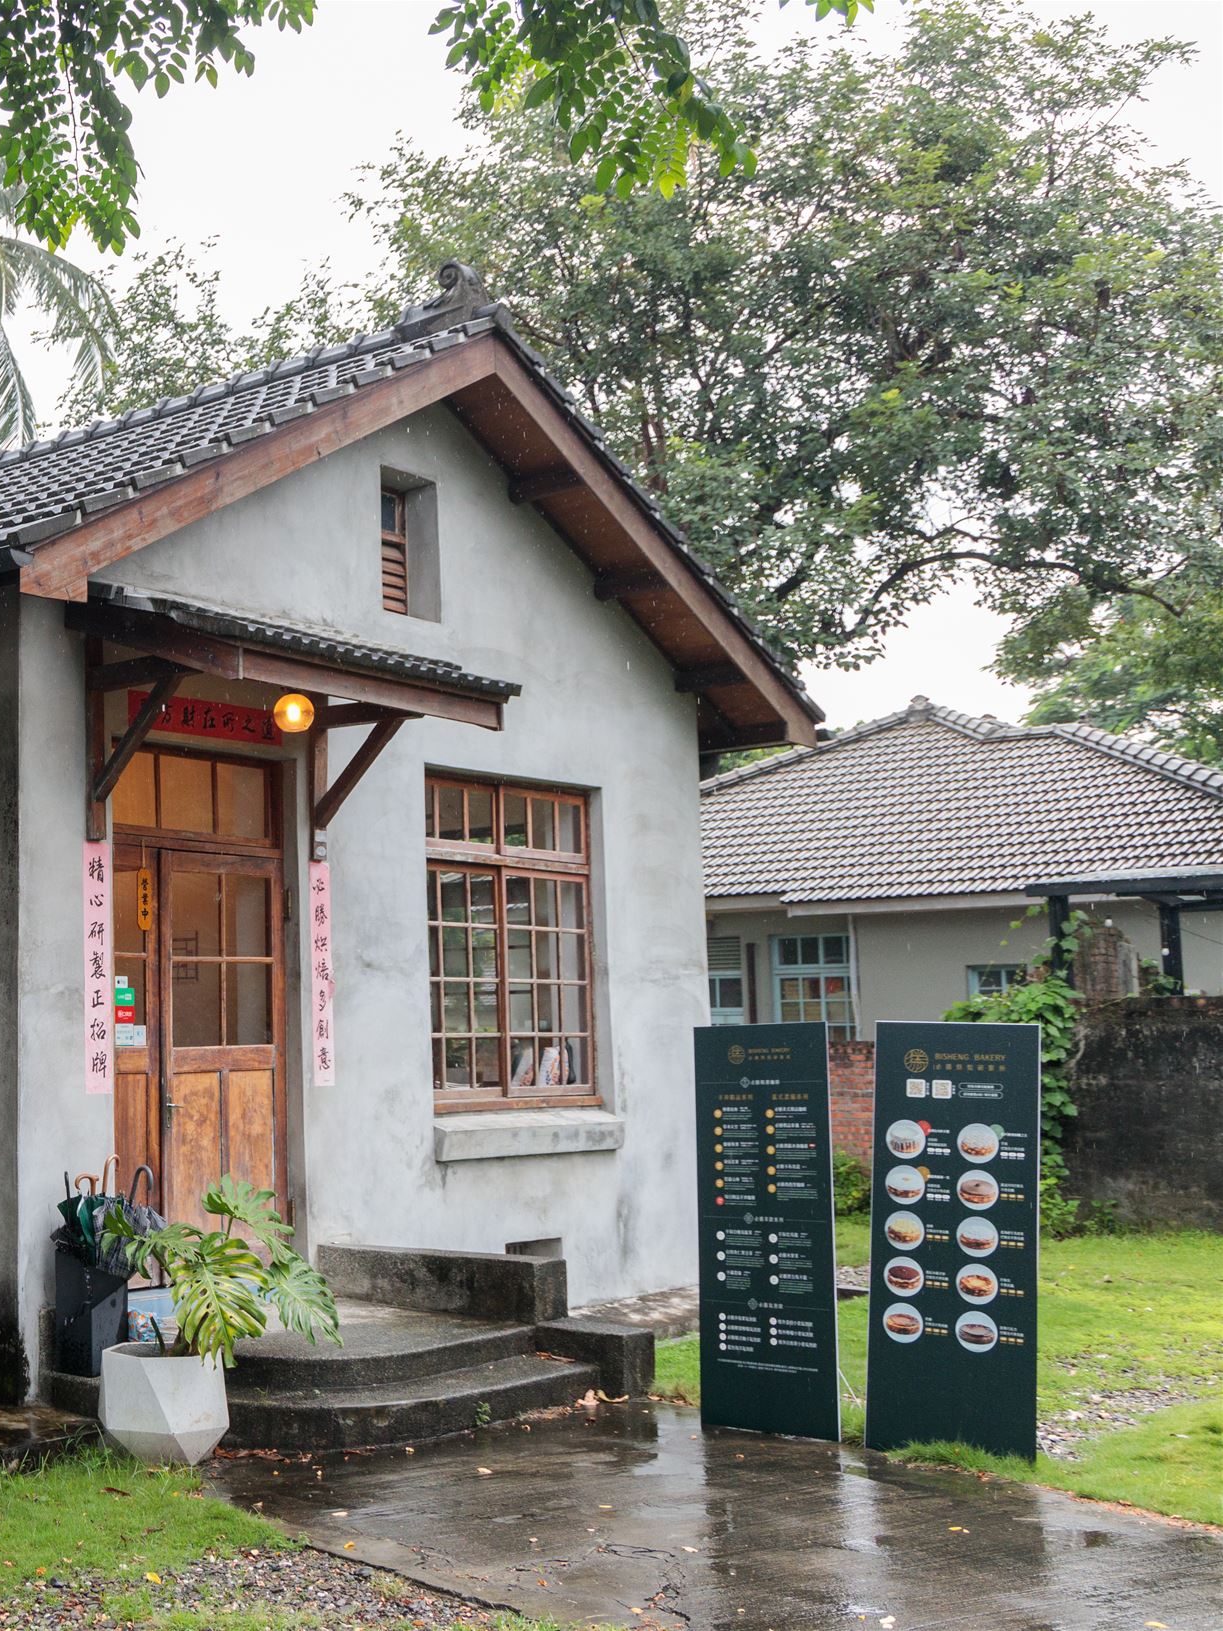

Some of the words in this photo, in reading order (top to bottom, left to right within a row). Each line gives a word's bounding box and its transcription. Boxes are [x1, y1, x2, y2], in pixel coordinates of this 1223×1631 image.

[88, 856, 108, 1078] 精心研製正招牌
[141, 878, 149, 920] 營業中
[312, 878, 332, 1071] 必勝烘焙多創意
